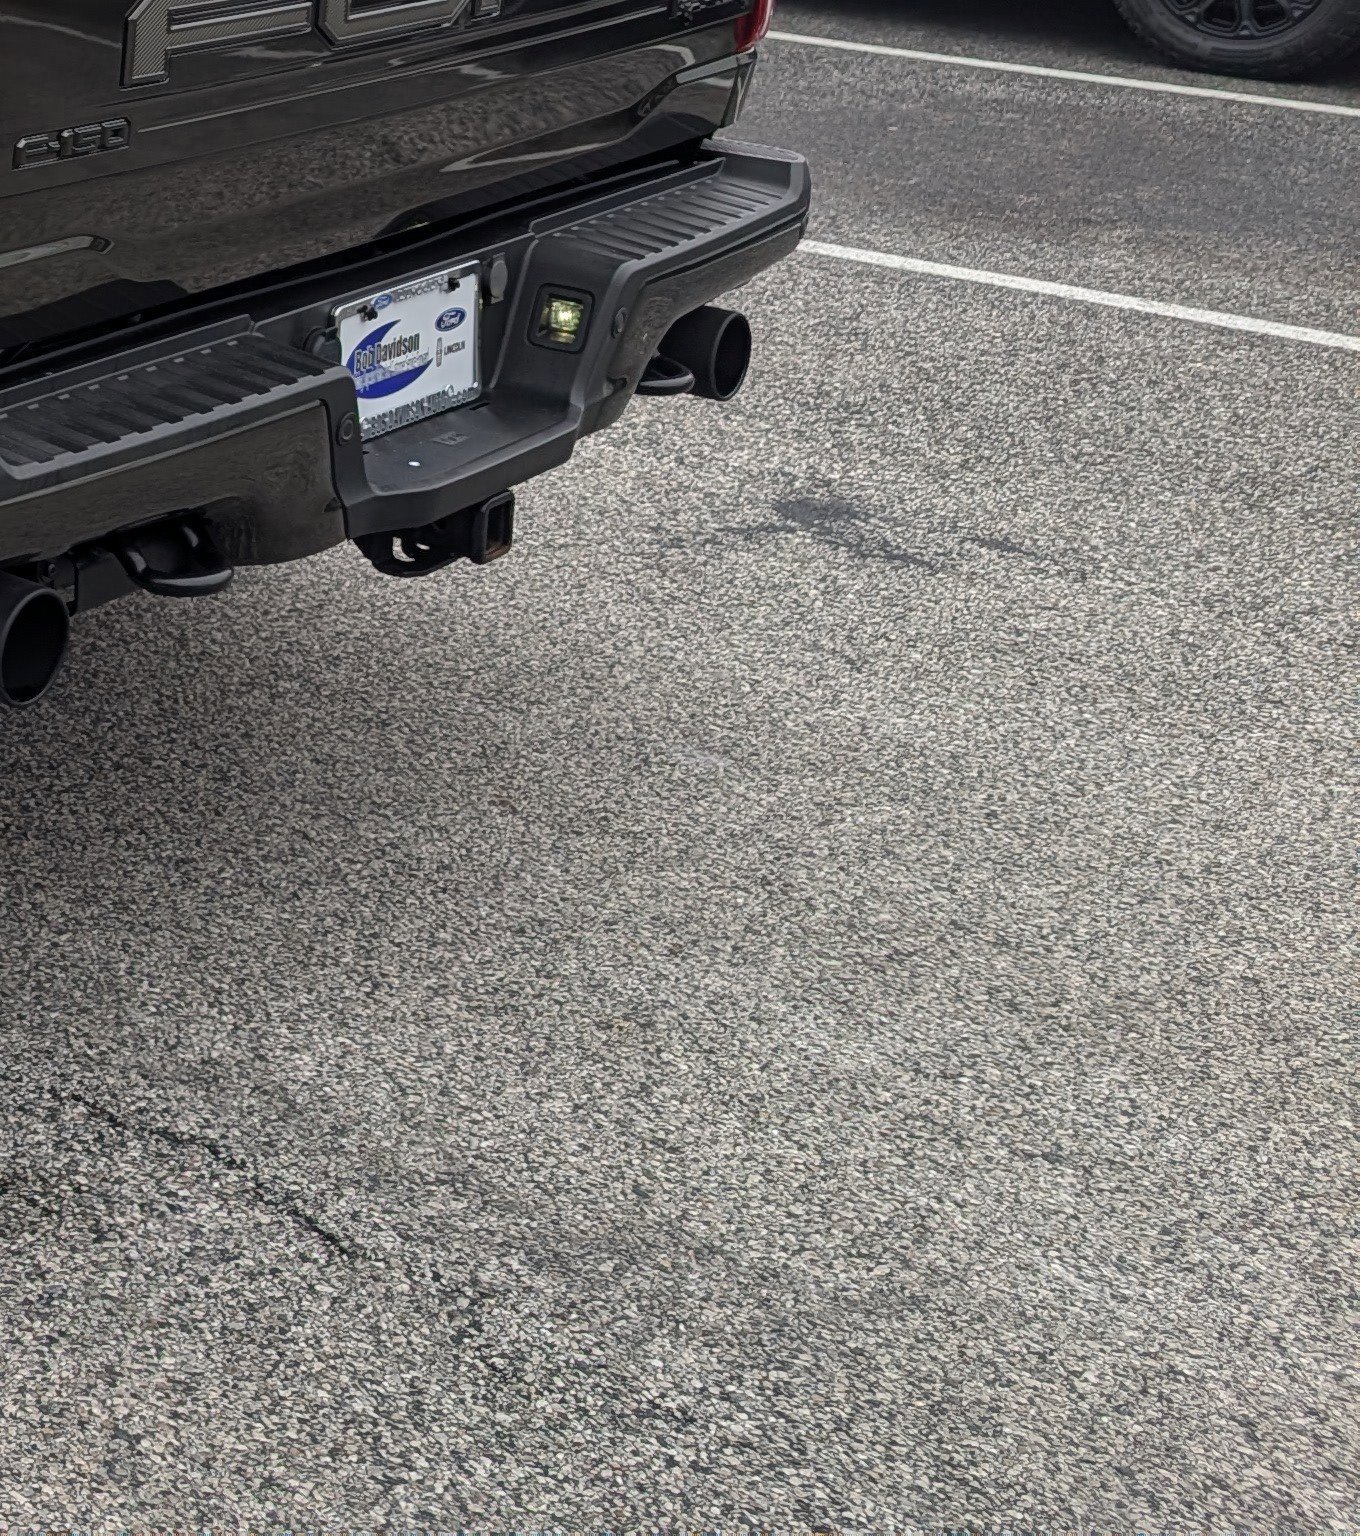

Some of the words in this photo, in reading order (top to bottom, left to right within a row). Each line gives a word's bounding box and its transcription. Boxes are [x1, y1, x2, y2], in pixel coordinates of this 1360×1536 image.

[12, 117, 131, 172] F-150
[354, 344, 375, 373] Bob
[375, 332, 420, 364] Davidson
